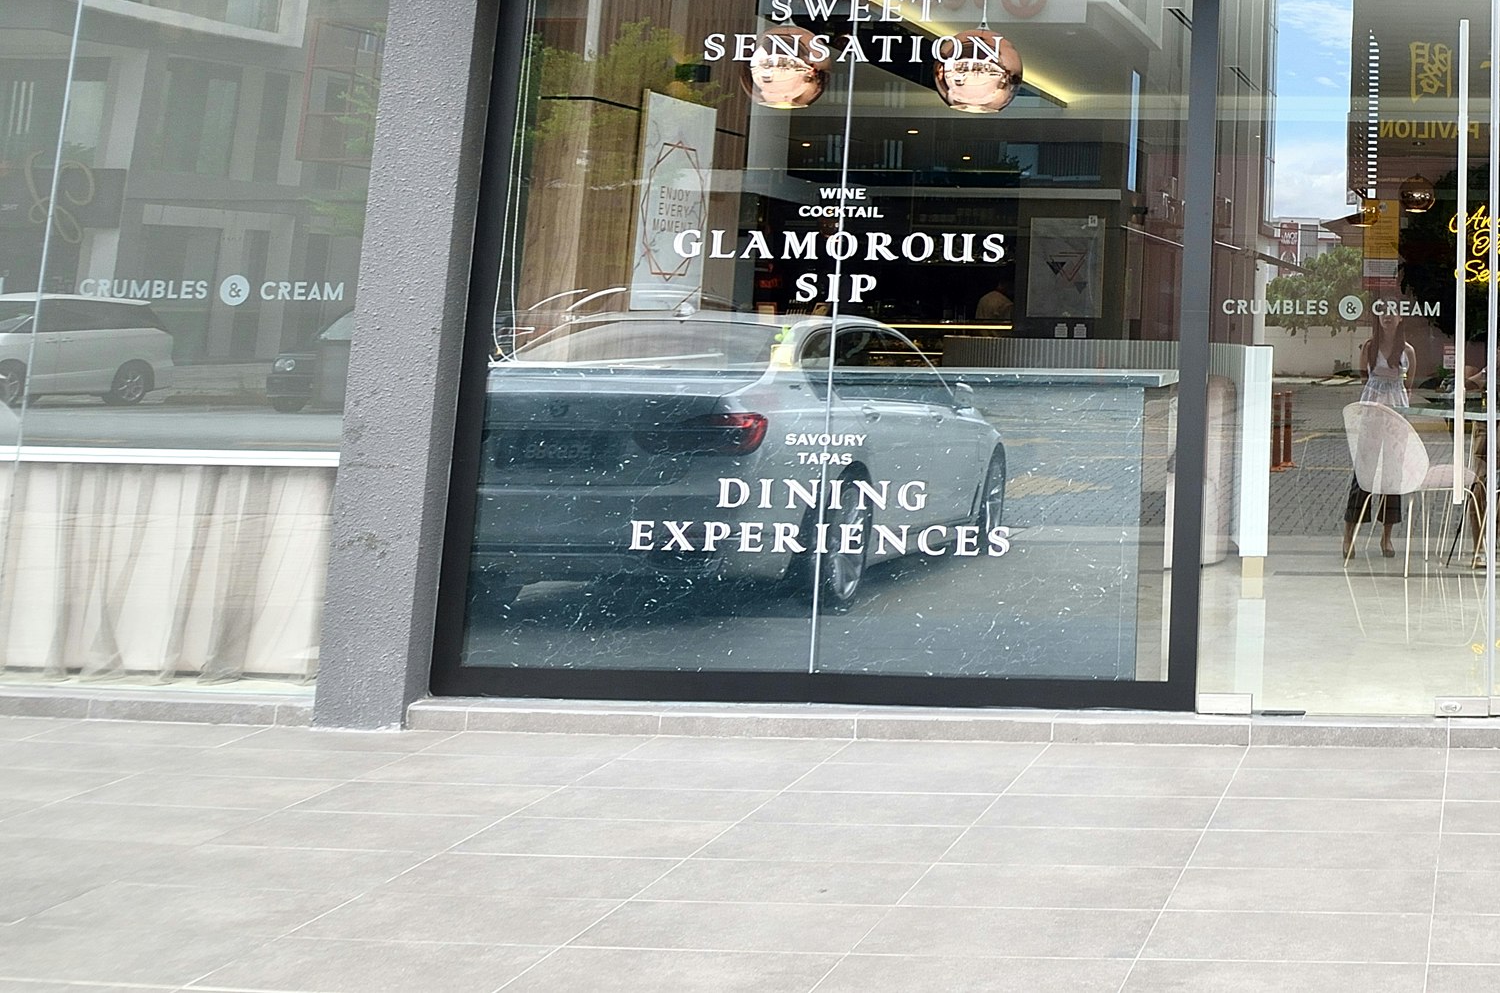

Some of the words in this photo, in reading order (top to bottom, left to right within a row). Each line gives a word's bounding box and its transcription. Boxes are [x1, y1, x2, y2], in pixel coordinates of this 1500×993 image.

[703, 33, 1004, 64] SENSATION
[660, 185, 691, 201] ENJOY
[820, 187, 867, 200] WINE
[658, 202, 690, 218] EVERY
[799, 205, 884, 219] COCKTAIL
[673, 229, 1005, 262] GLAMOROUS
[79, 278, 208, 299] CRUMBLES
[260, 281, 345, 301] CREAM
[795, 273, 877, 303] SIP
[1222, 299, 1329, 316] CRUMBLES
[1371, 299, 1441, 317] CREAM
[784, 433, 867, 447] SAVOURY
[797, 452, 853, 466] TAPAS
[716, 477, 928, 513] DINING
[628, 519, 1011, 558] EXPERIENCES
